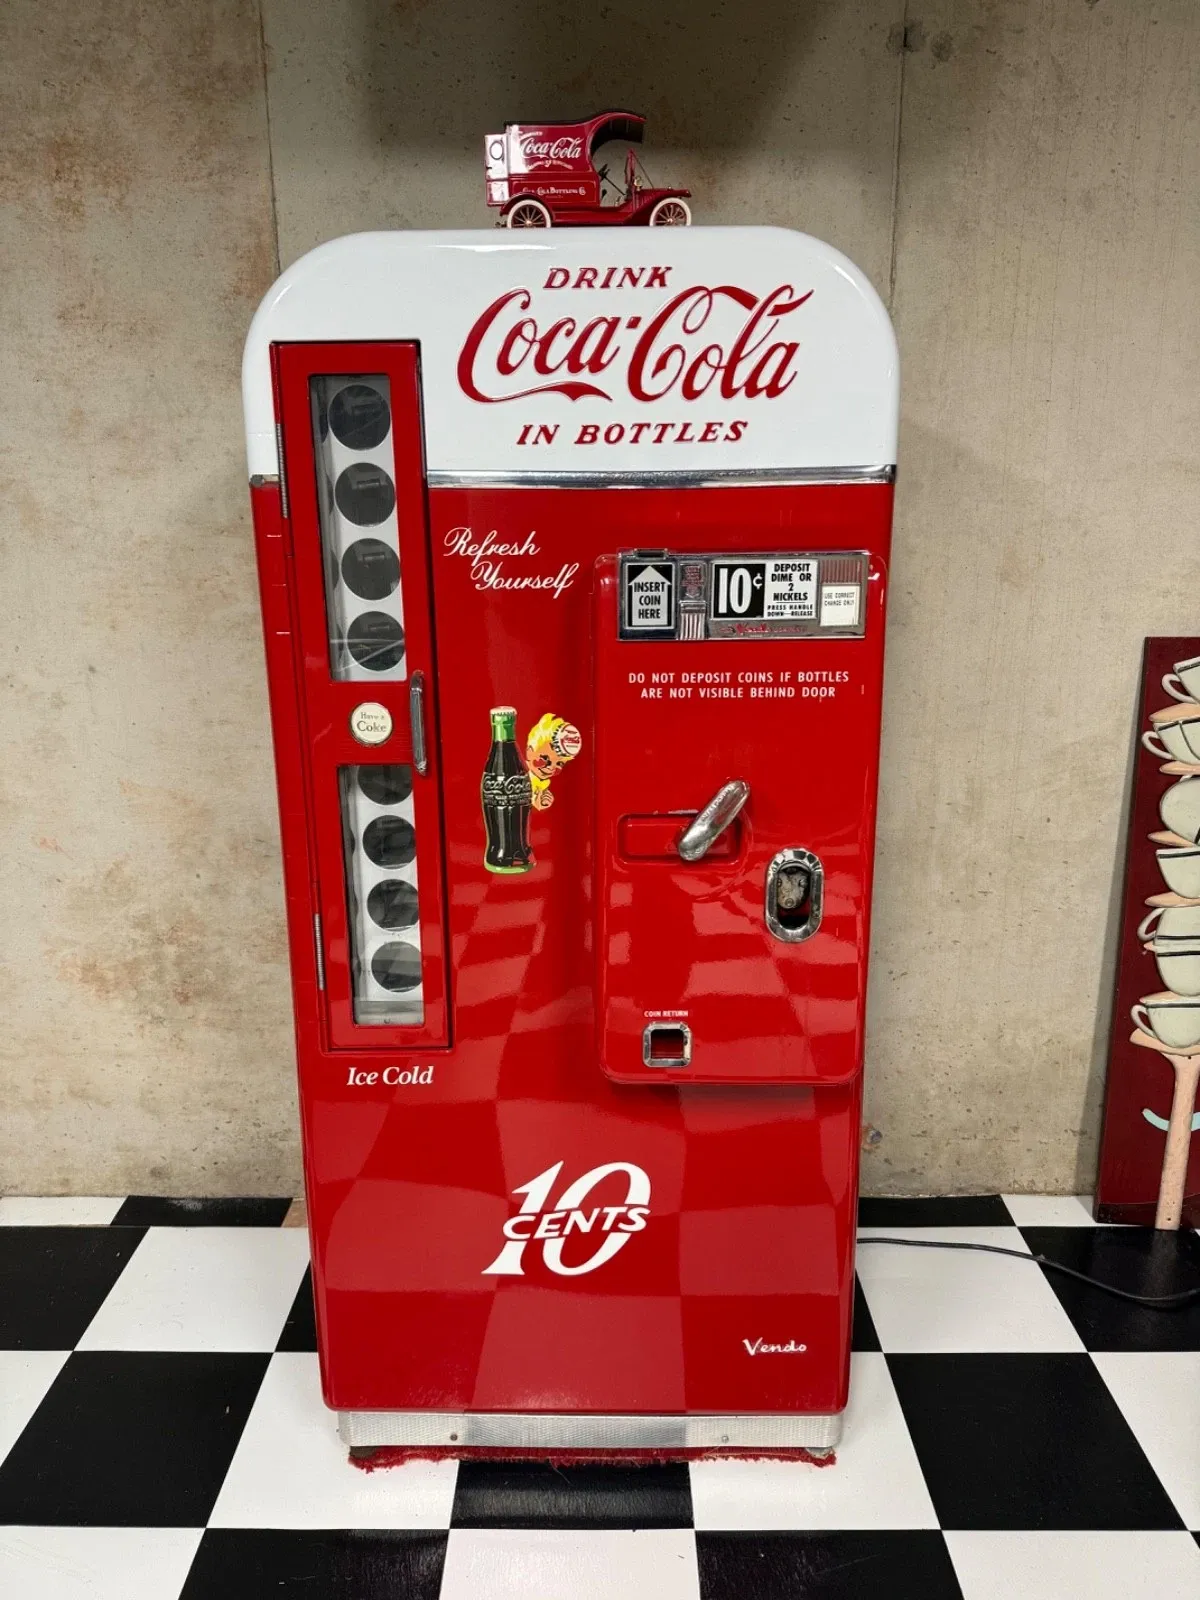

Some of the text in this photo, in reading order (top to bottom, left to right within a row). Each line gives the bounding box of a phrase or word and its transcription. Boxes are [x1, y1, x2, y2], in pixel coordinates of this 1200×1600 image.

[520, 137, 584, 159] Coca-Cola
[543, 266, 673, 289] DRINK
[456, 284, 814, 403] Coca-Cola
[516, 421, 749, 445] IN BOTTLES
[443, 526, 541, 567] Refresh
[774, 563, 810, 572] DEPOSIT
[470, 561, 580, 599] Yourself
[771, 573, 812, 582] DIME OR
[633, 581, 665, 593] INSERT
[788, 583, 794, 592] 2
[639, 595, 661, 607] COIN
[773, 592, 808, 601] NICKELS
[789, 603, 813, 611] HANDLE
[638, 608, 661, 619] HERE
[629, 671, 849, 683] DO NOT DEPOSIT COINS IF BOTTLES
[640, 687, 836, 698] ARE NOT VISIBLE BEHIND DOOR
[357, 720, 387, 732] Coke
[347, 1065, 434, 1086] Ice Cold
[481, 1160, 652, 1276] 10
[502, 1205, 651, 1242] CENTS
[742, 1338, 807, 1357] Vendo
